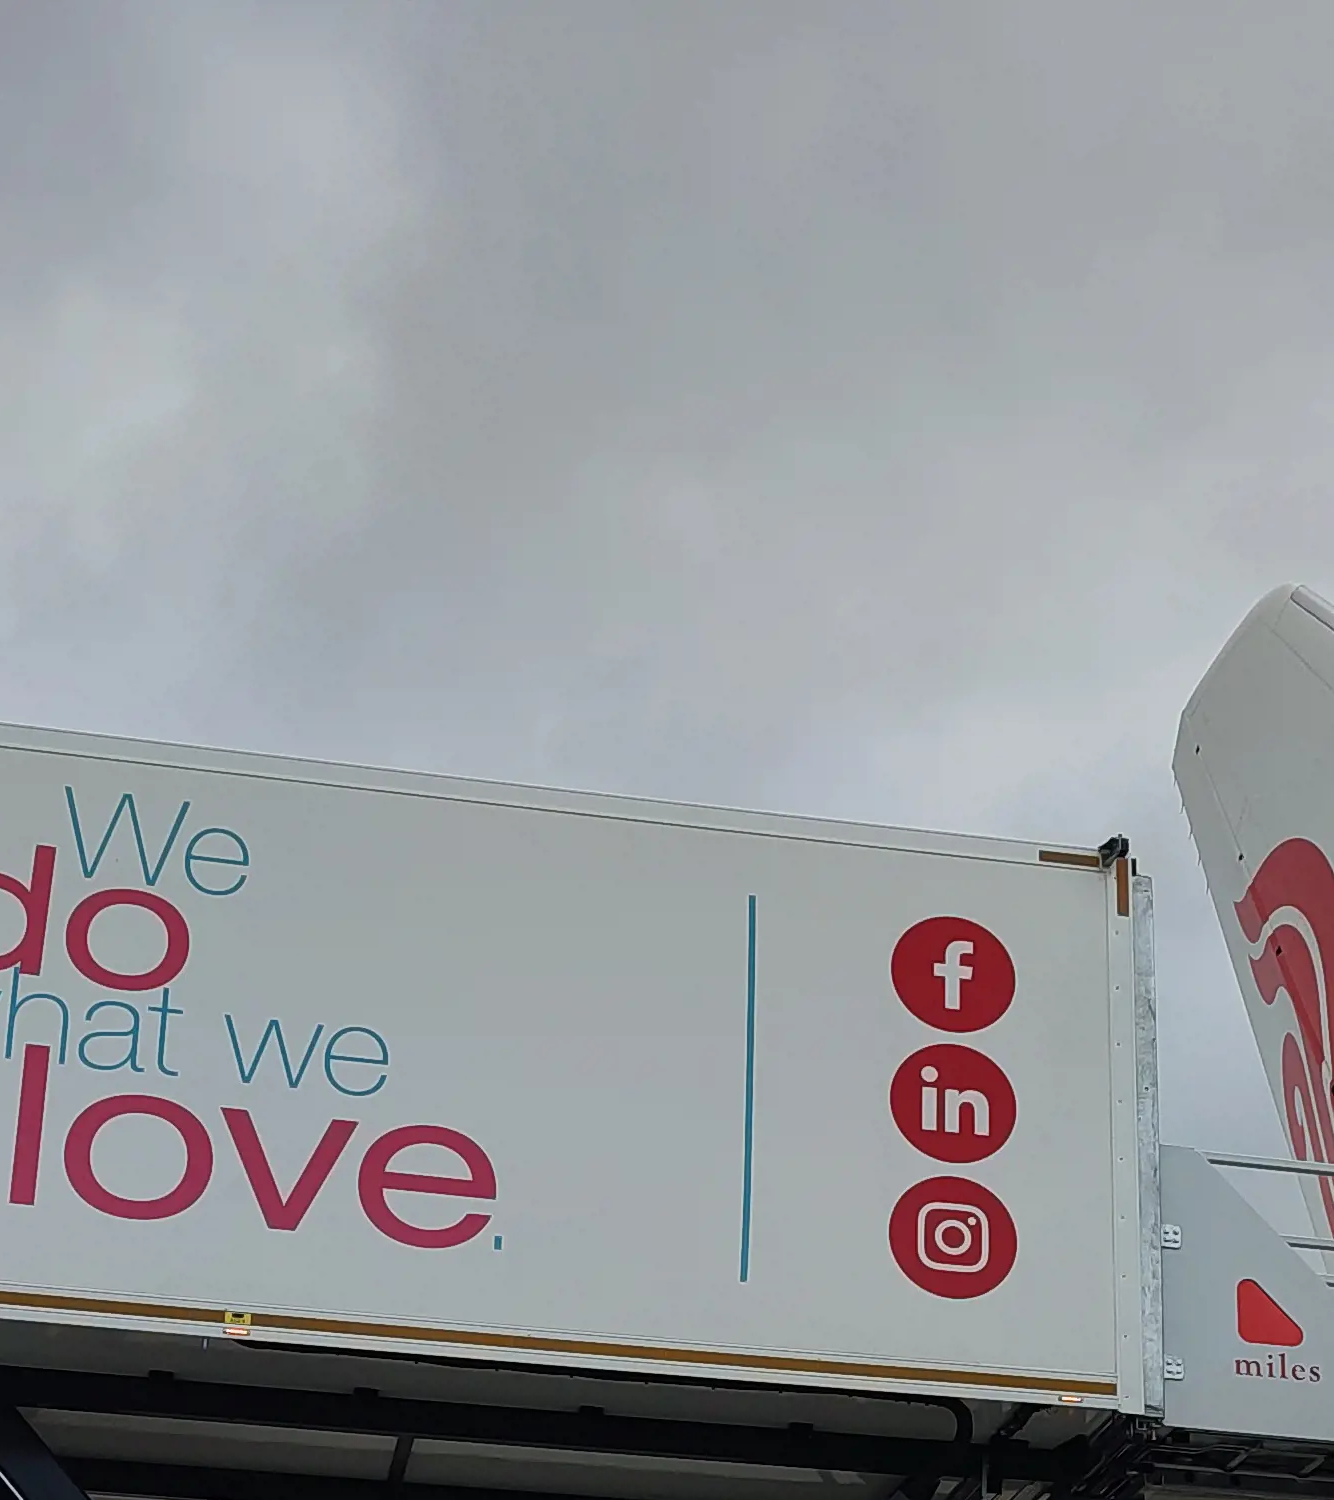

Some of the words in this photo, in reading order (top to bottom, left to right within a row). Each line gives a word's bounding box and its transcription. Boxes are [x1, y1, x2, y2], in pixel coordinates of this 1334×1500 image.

[64, 785, 250, 896] We
[224, 1013, 389, 1097] we
[919, 1065, 990, 1136] in
[1234, 1355, 1322, 1383] miles
